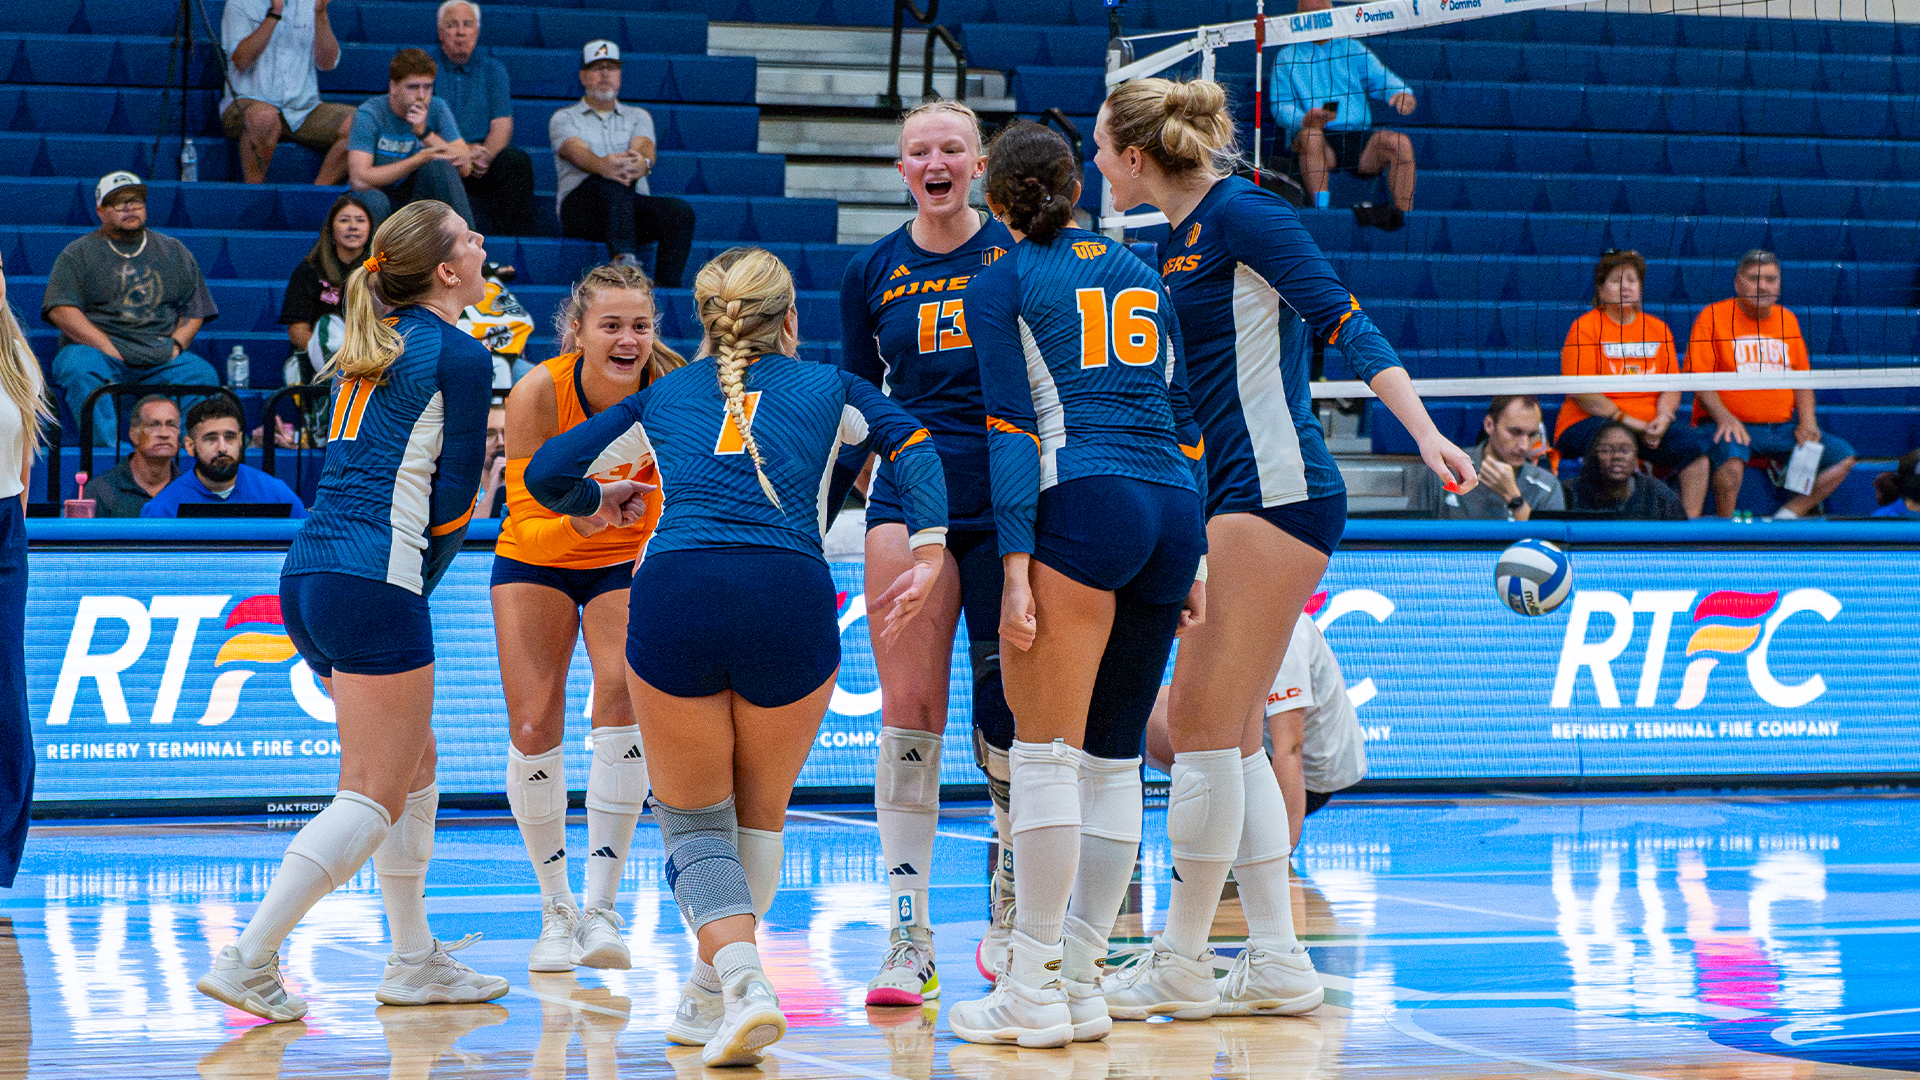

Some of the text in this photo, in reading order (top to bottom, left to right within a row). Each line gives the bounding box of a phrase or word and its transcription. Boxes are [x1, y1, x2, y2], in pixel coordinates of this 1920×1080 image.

[1072, 241, 1107, 260] UTEP
[881, 275, 977, 305] MINE
[918, 298, 973, 354] 13
[1076, 287, 1159, 369] 16
[1551, 588, 1843, 710] RTFC
[1552, 720, 1840, 740] REFINERY TERMINAL FIRE COMPANY
[47, 743, 140, 759] REFINERY
[147, 740, 245, 758] TERMINAL
[252, 740, 294, 757] FIRE
[267, 803, 332, 812] DAKTRON
